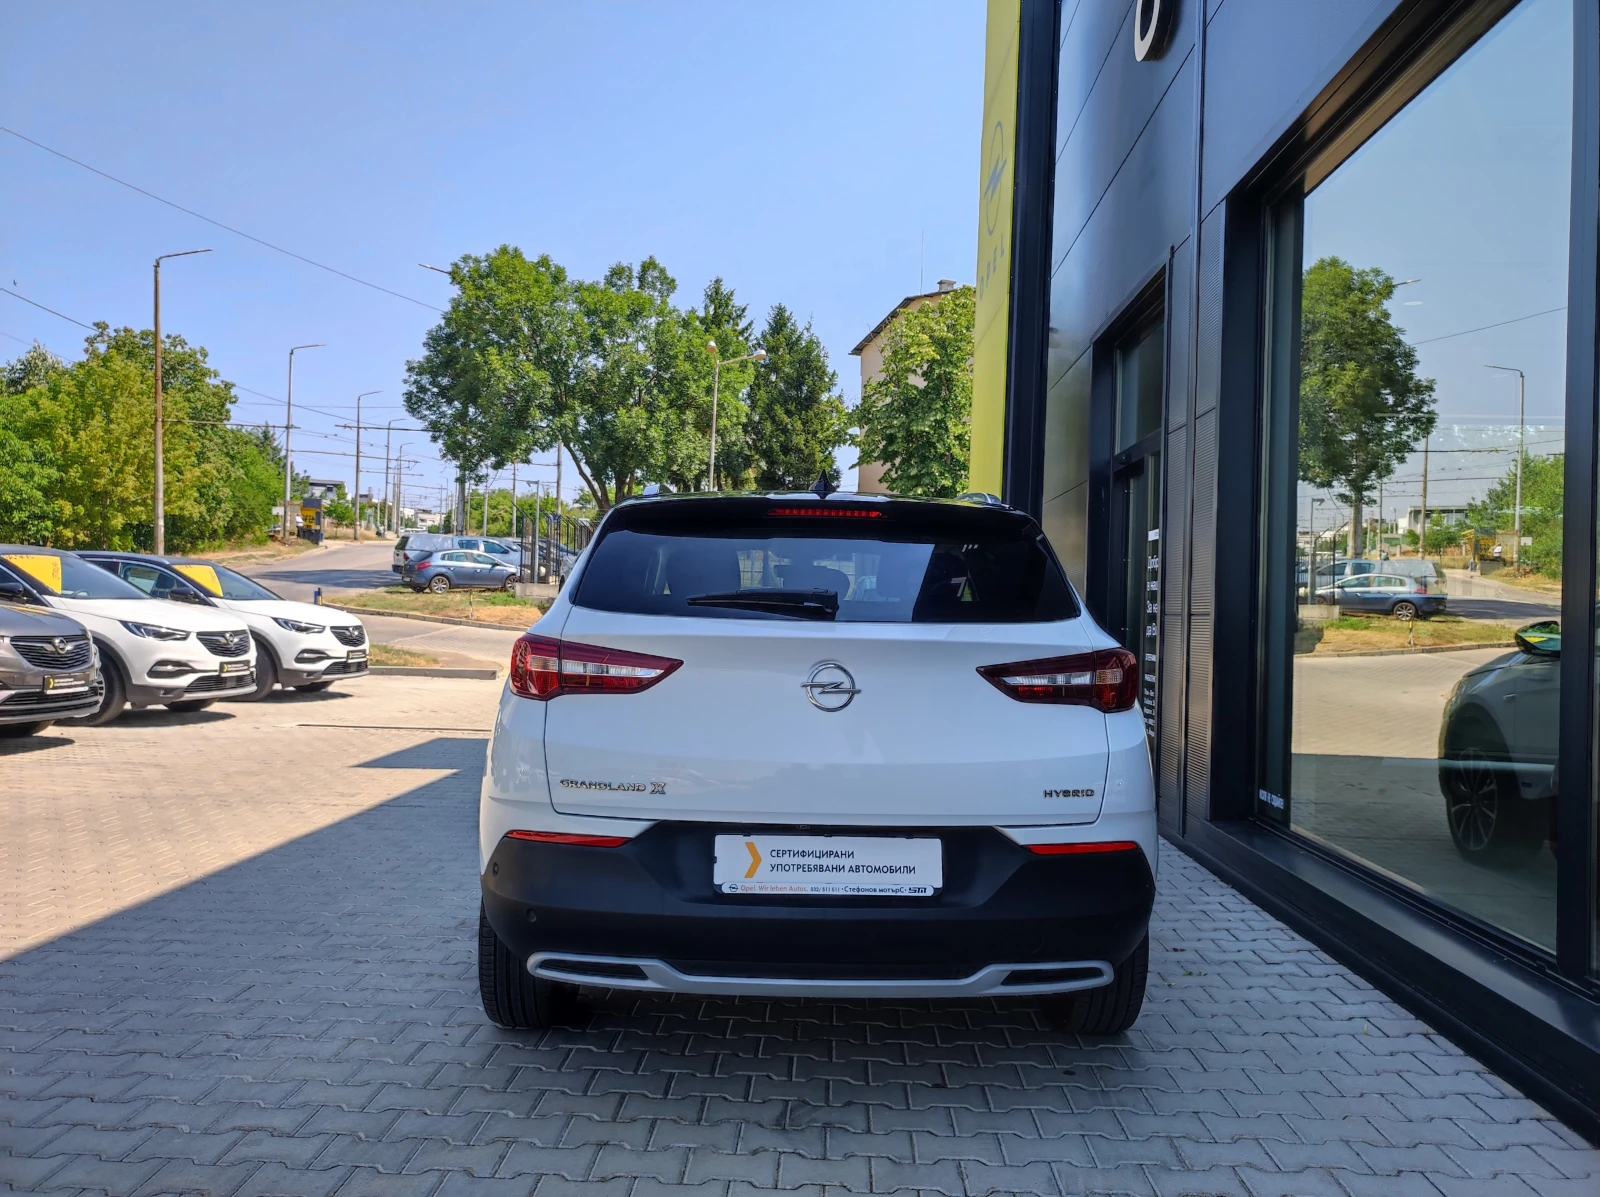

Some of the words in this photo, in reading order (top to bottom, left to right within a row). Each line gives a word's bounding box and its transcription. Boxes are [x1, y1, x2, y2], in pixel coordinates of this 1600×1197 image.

[560, 779, 646, 792] GRANDLAND
[650, 782, 666, 794] X
[1043, 789, 1094, 798] HYBRID
[770, 849, 855, 860] СЕРТИФИЦИРАНИ
[770, 863, 845, 873] УПОТРЕБЯВАНИ
[848, 864, 916, 875] АВТОМОБИЛИ
